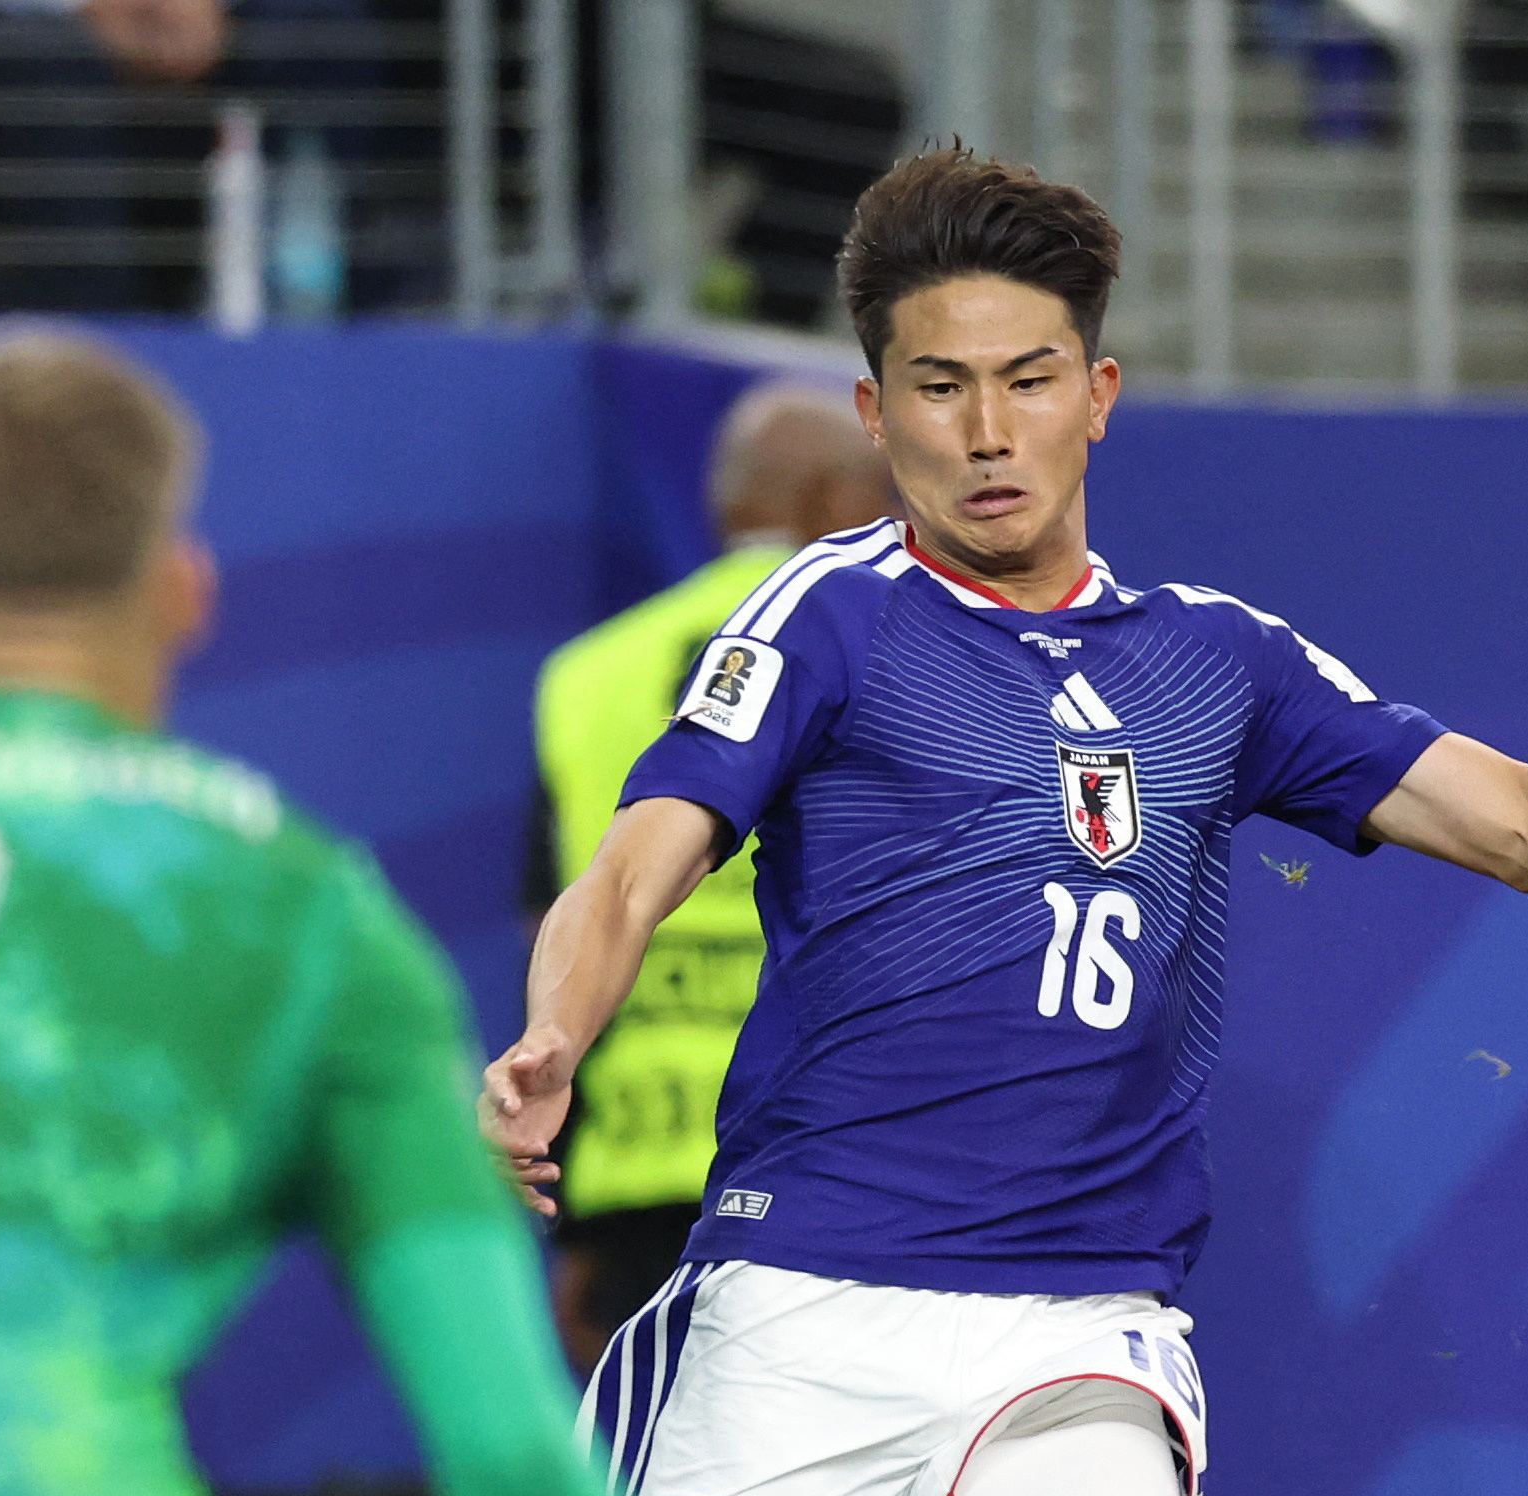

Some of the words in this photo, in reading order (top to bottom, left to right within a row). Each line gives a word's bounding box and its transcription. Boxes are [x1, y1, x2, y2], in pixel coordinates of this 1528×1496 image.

[1069, 752, 1110, 766] JAPAN
[1084, 827, 1117, 847] JFA
[1037, 881, 1141, 1031] 16
